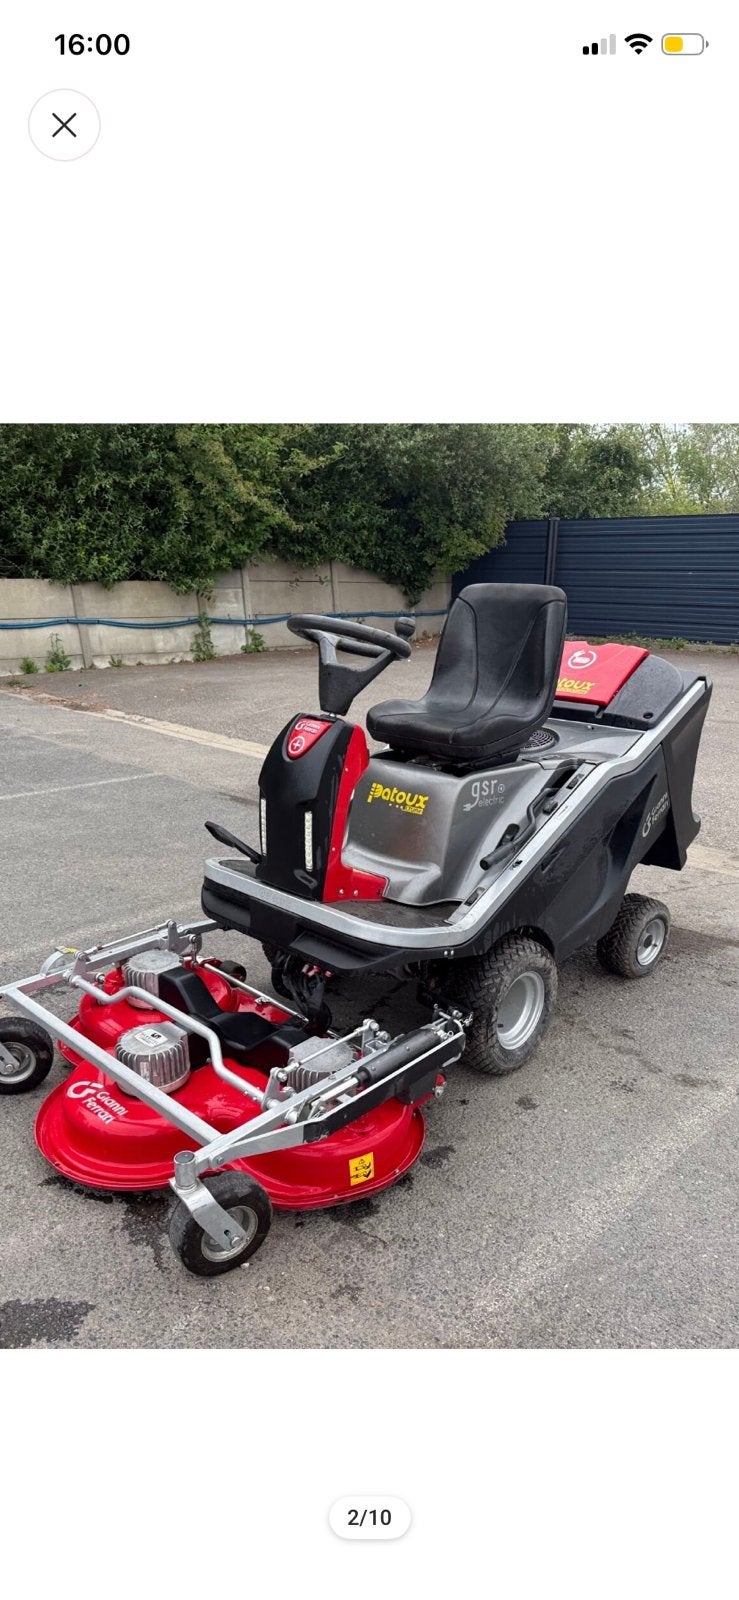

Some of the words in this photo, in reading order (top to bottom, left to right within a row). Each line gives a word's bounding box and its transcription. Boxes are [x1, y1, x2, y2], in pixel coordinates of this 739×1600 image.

[557, 677, 596, 691] toux
[367, 782, 429, 809] Patoux
[469, 779, 498, 808] gsr
[478, 794, 505, 808] electric
[81, 1096, 115, 1125] Ferrari
[96, 1091, 129, 1116] Gianni
